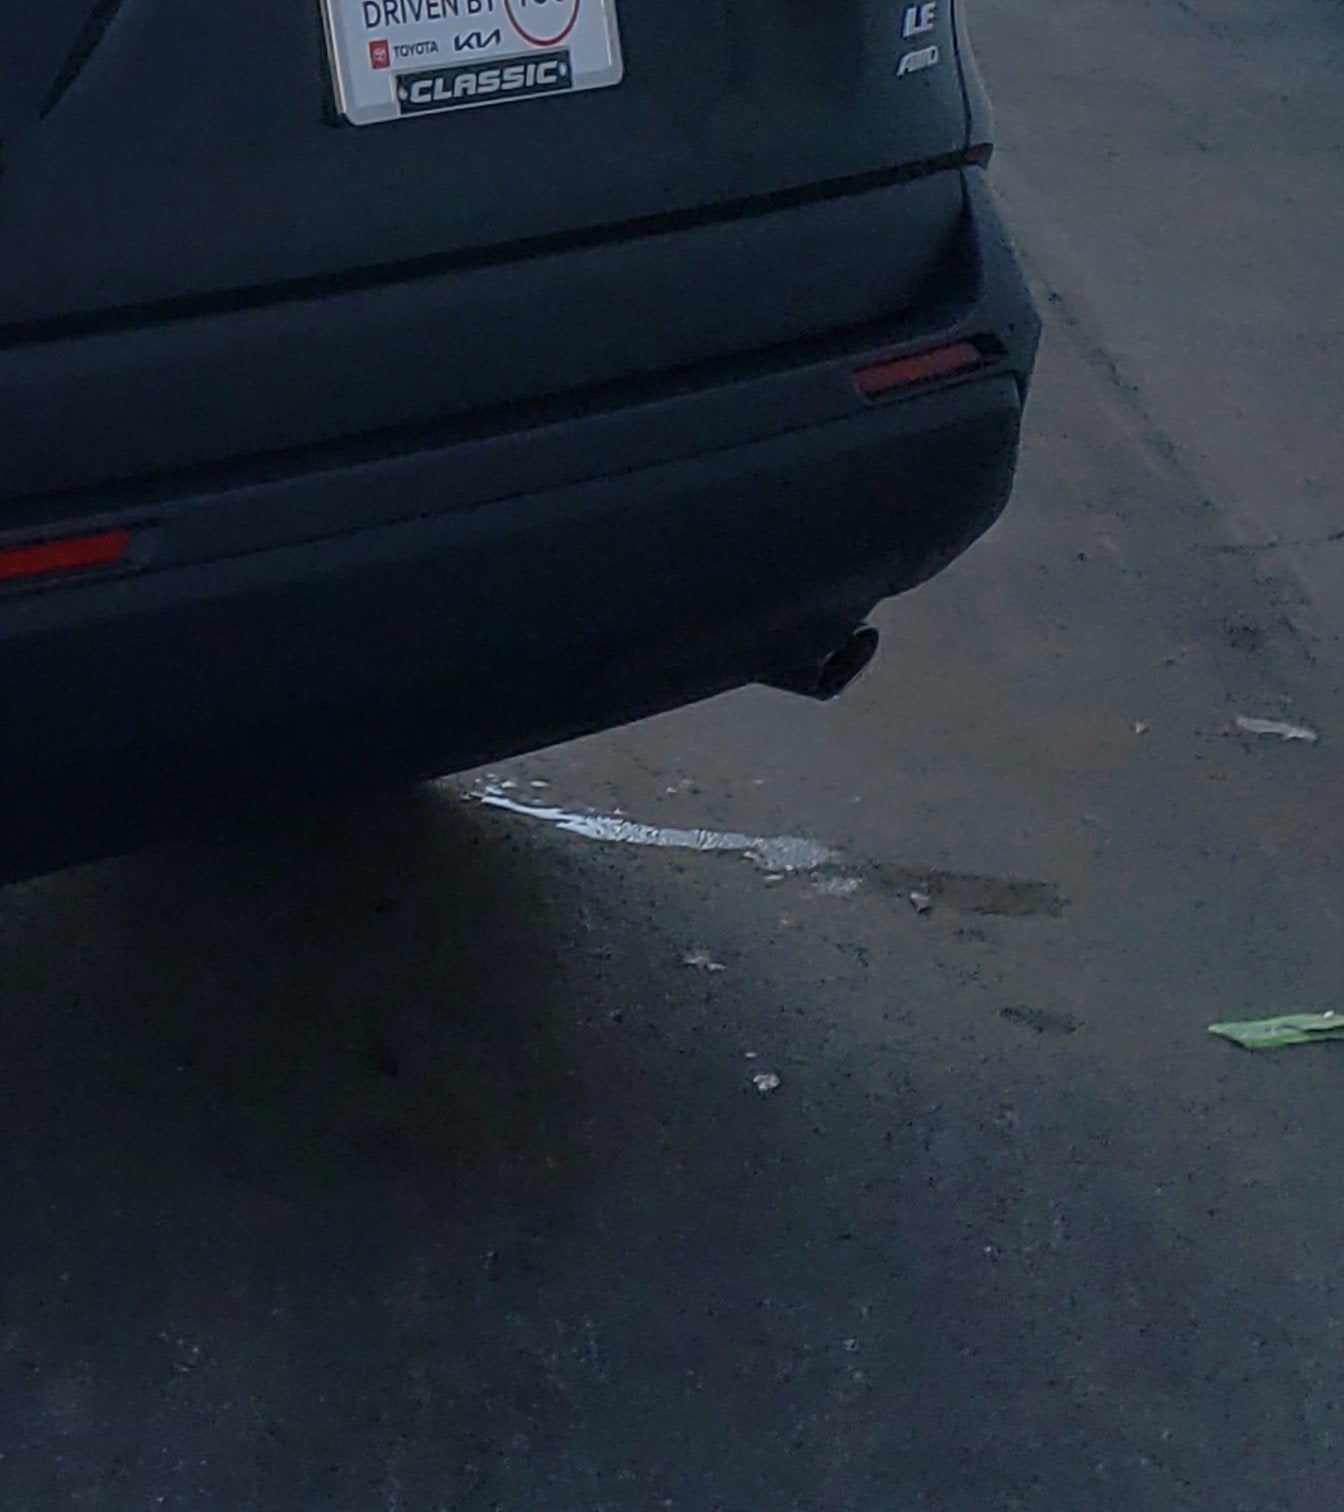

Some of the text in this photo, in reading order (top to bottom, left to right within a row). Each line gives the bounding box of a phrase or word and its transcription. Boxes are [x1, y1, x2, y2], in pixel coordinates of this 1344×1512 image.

[902, 1, 936, 38] LE
[393, 41, 439, 58] TOYOTA
[409, 61, 558, 103] CLASSIC
